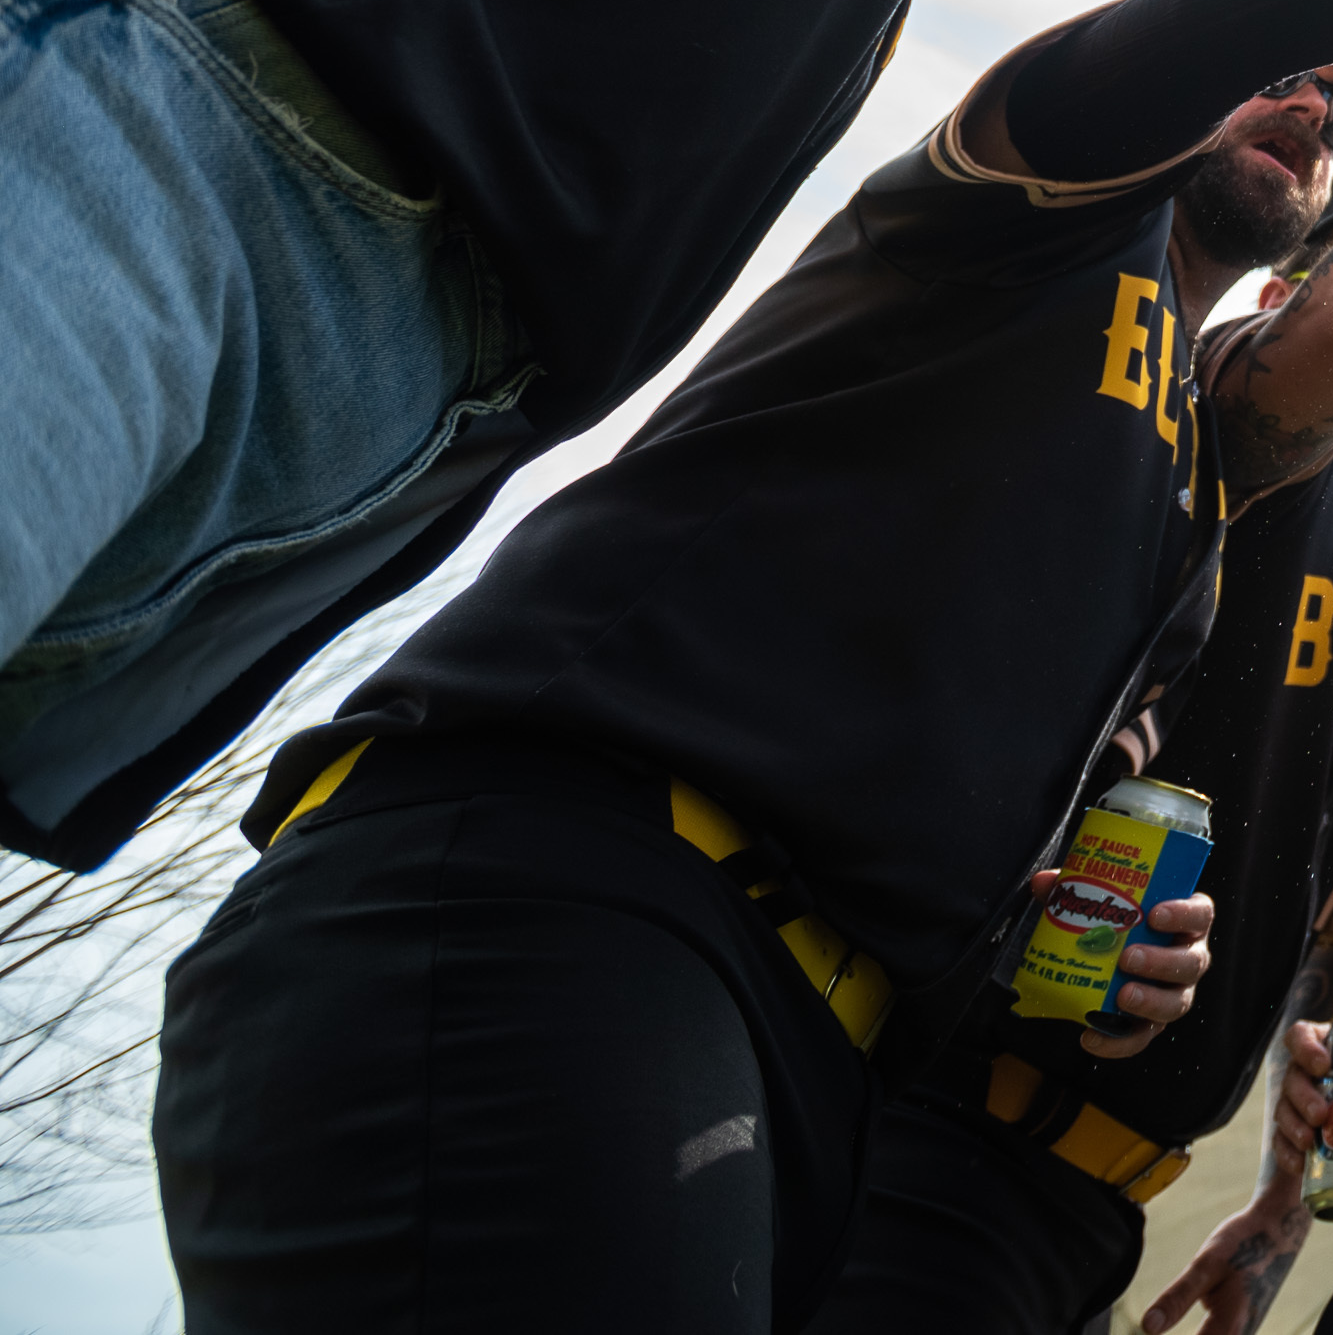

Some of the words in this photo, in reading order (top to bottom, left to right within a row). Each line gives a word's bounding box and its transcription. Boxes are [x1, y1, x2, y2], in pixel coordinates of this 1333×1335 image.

[1080, 834, 1101, 848] HOT
[1099, 839, 1142, 860] SAUCE
[1083, 857, 1150, 890] HABANERO
